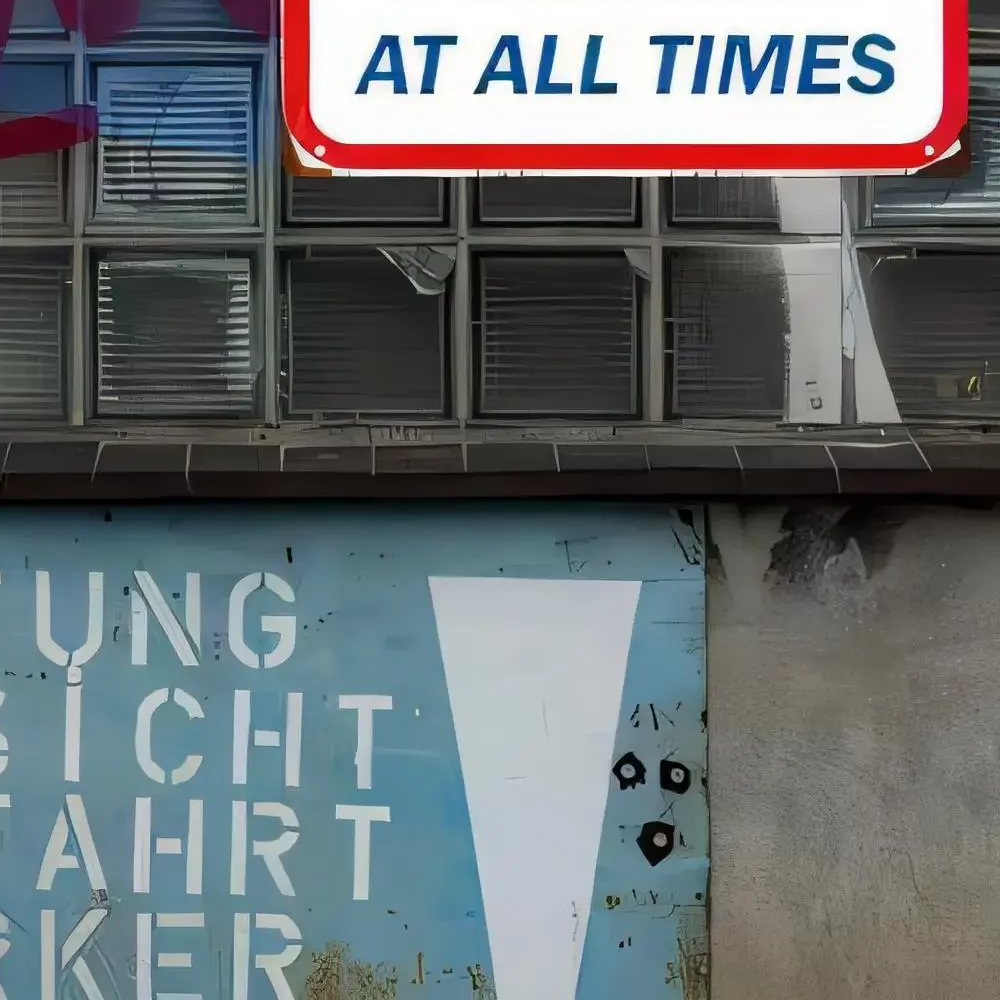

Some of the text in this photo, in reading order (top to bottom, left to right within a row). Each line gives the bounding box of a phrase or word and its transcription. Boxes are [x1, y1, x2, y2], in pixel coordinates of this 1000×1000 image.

[354, 33, 897, 95] AT ALL TIMES
